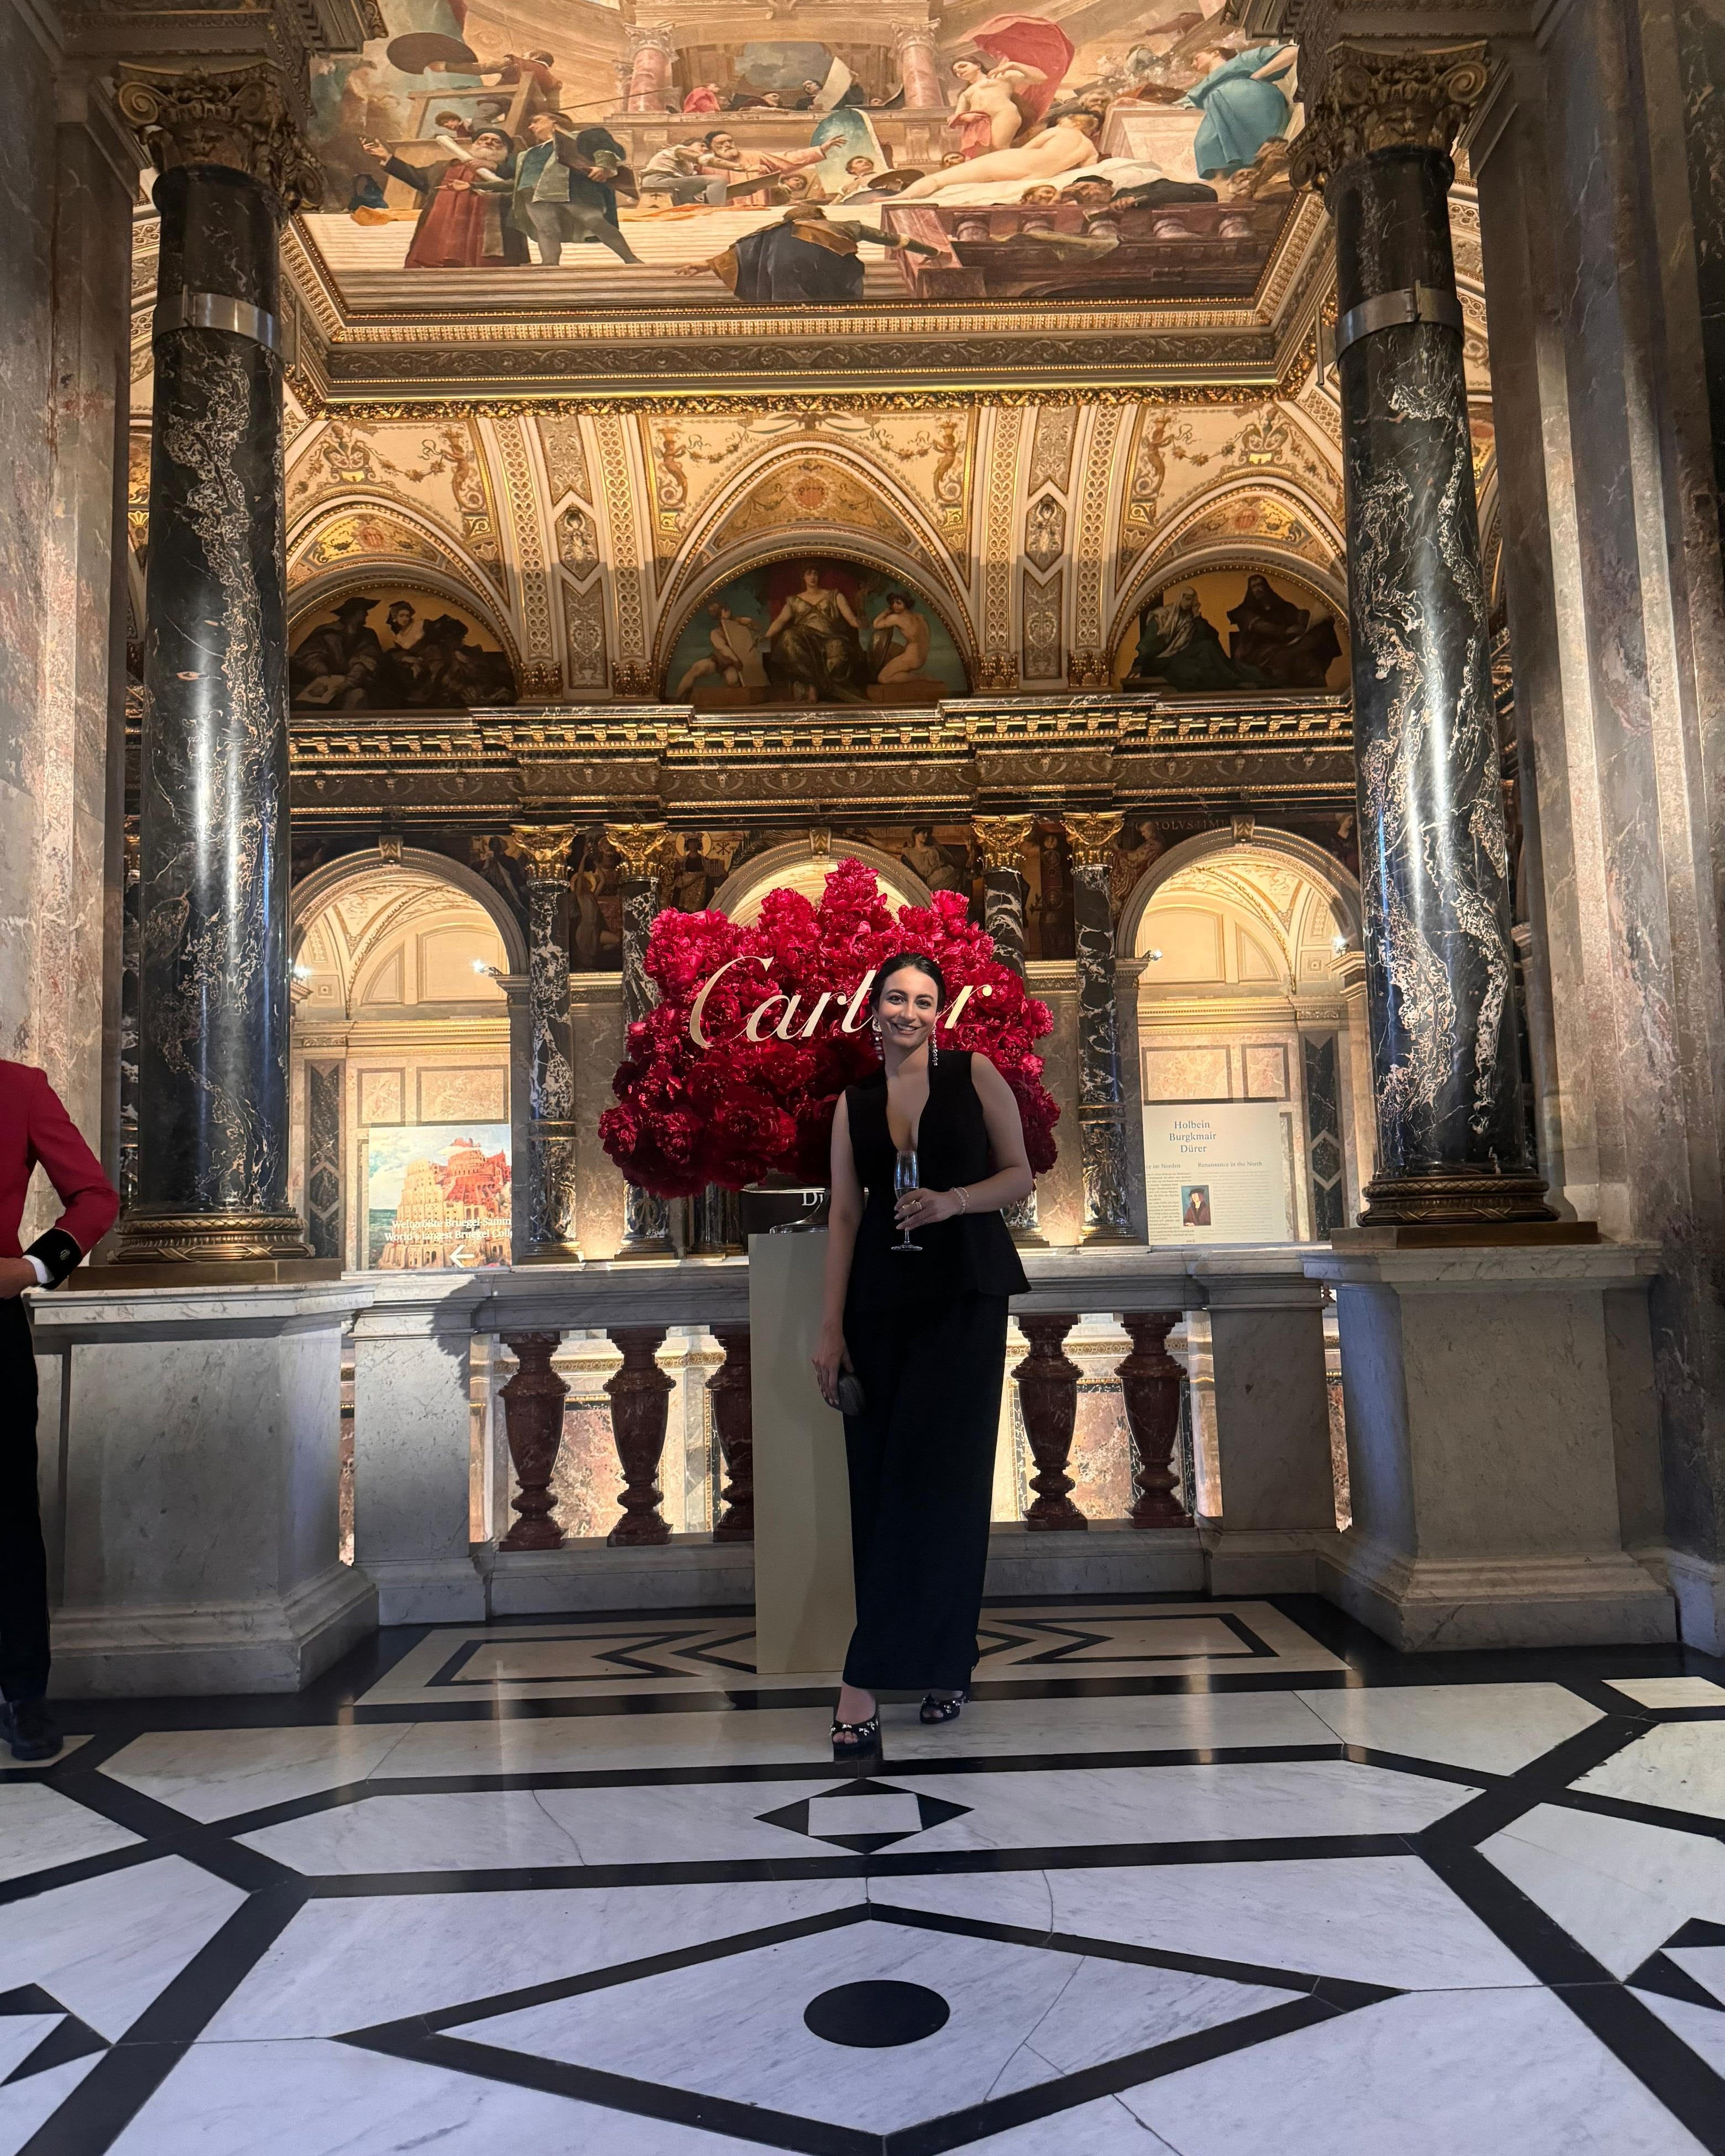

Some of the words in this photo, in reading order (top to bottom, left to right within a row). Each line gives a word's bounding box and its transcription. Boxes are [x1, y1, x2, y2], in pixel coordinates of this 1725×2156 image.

[689, 955, 992, 1048] Cartr
[1174, 1120, 1210, 1129] Holbein
[1169, 1132, 1216, 1143] Burgkmair
[1180, 1144, 1206, 1153] Dürer
[422, 1230, 452, 1242] largest
[454, 1228, 490, 1241] Bruegel
